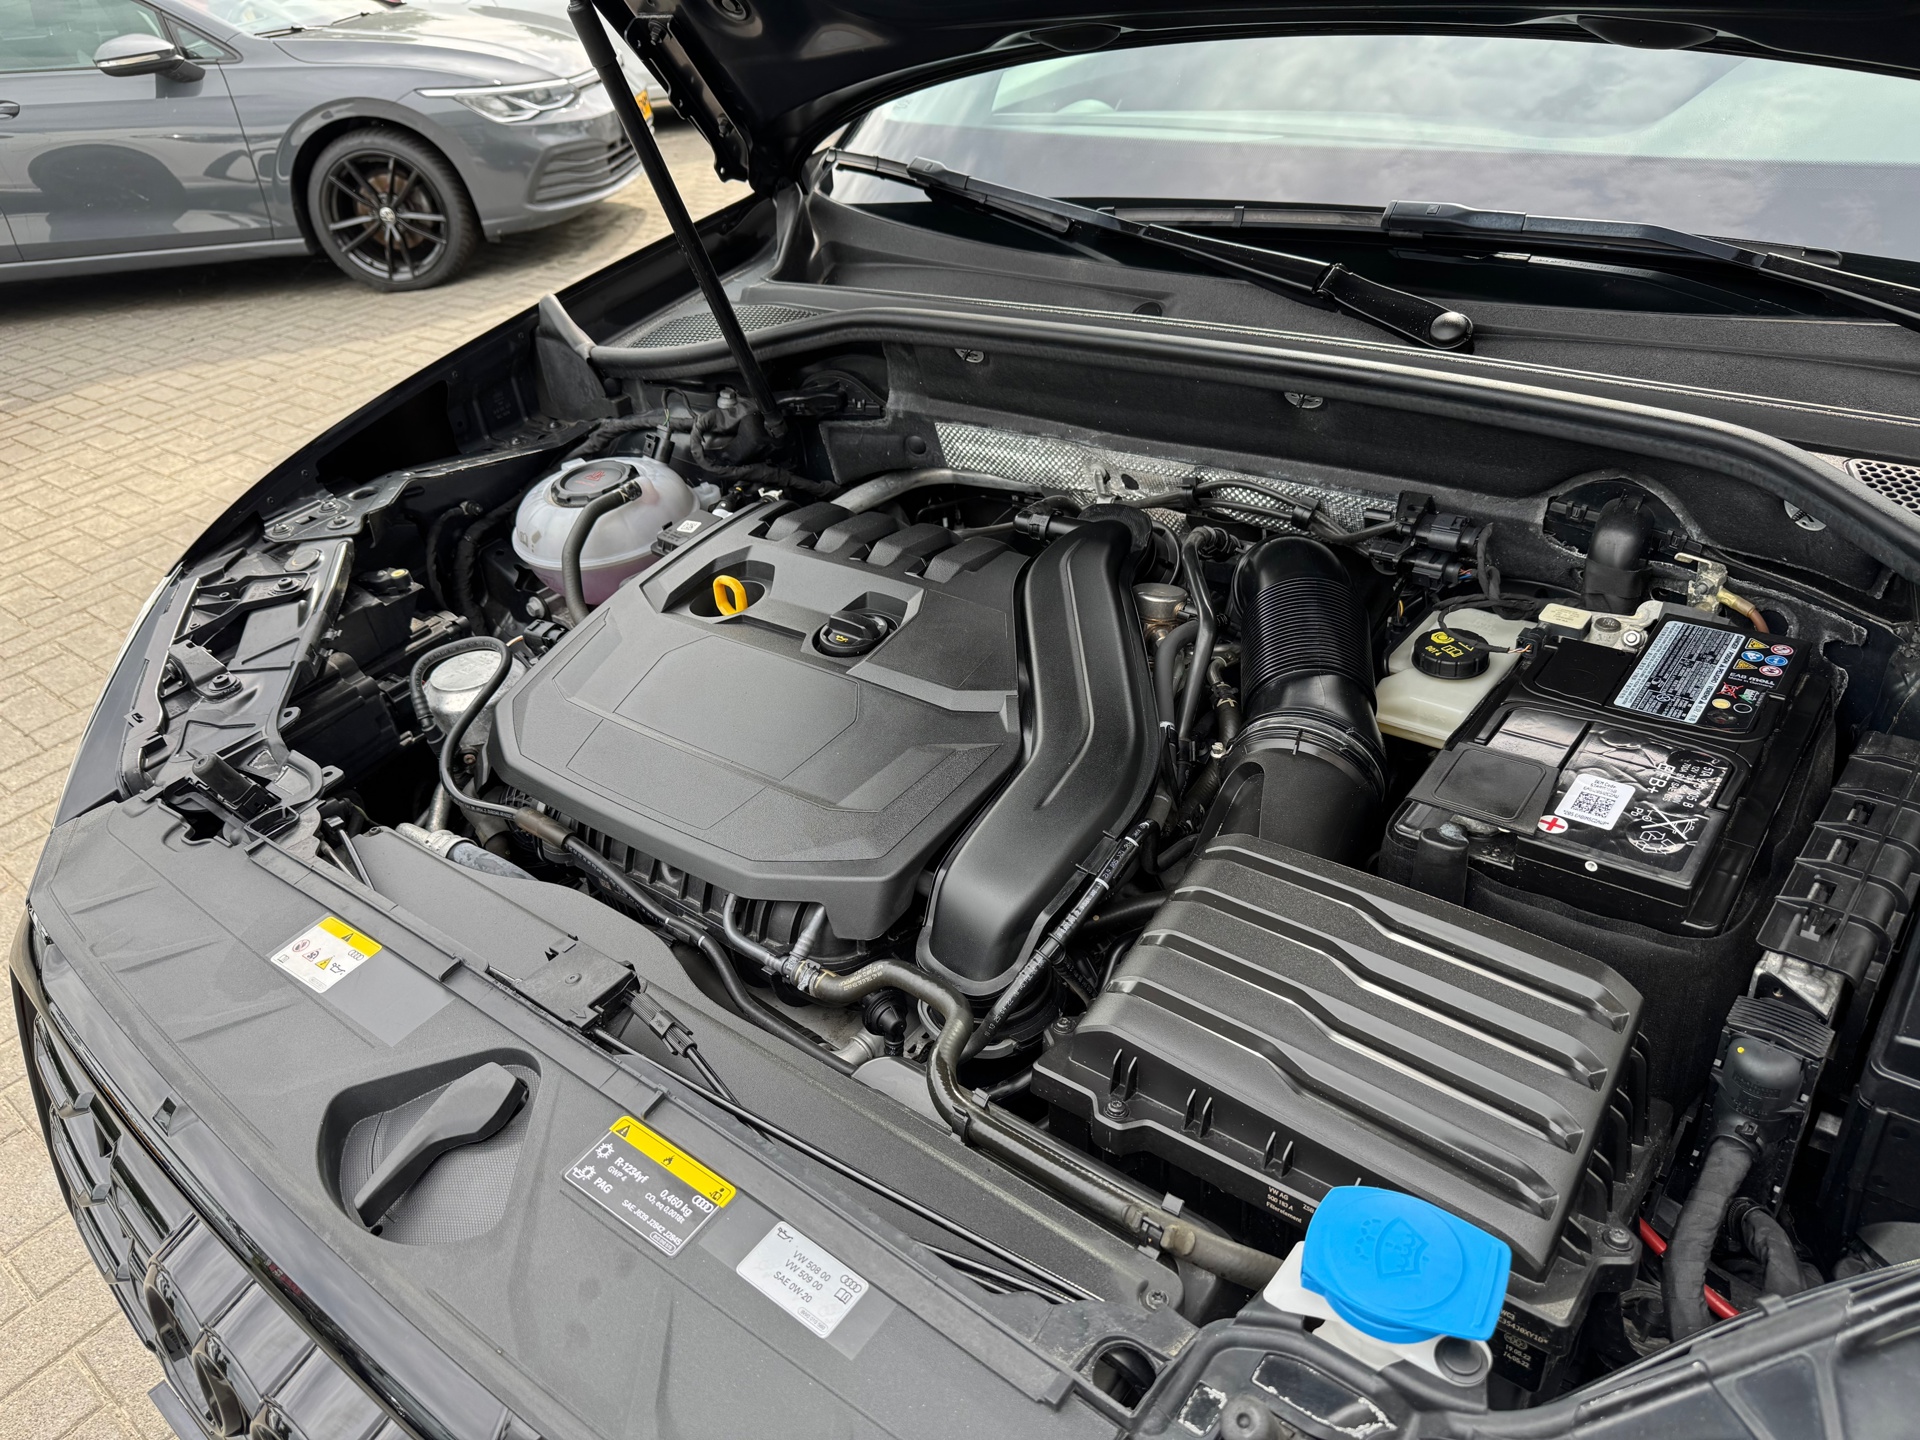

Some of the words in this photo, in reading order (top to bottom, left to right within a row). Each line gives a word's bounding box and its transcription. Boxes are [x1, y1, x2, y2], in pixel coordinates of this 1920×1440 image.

[593, 1176, 613, 1195] PAG
[607, 1165, 623, 1178] GWP
[655, 1201, 665, 1211] eq
[614, 1157, 649, 1183] R-1234yf
[660, 1189, 683, 1209] 0,460
[680, 1203, 693, 1217] kg
[1268, 1186, 1279, 1195] VW
[1279, 1192, 1289, 1201] AG
[621, 1199, 637, 1212] SAE
[633, 1208, 649, 1221] J639
[646, 1218, 666, 1234] J2842
[663, 1230, 683, 1246] J2845
[1266, 1201, 1302, 1224] Filterelement
[785, 1259, 801, 1273] VW
[797, 1269, 814, 1284] 509
[811, 1280, 823, 1291] 00
[793, 1250, 809, 1264] VW
[805, 1260, 822, 1275] 508
[819, 1271, 831, 1282] 00
[773, 1270, 791, 1287] SAE
[788, 1282, 813, 1303] 0W-20
